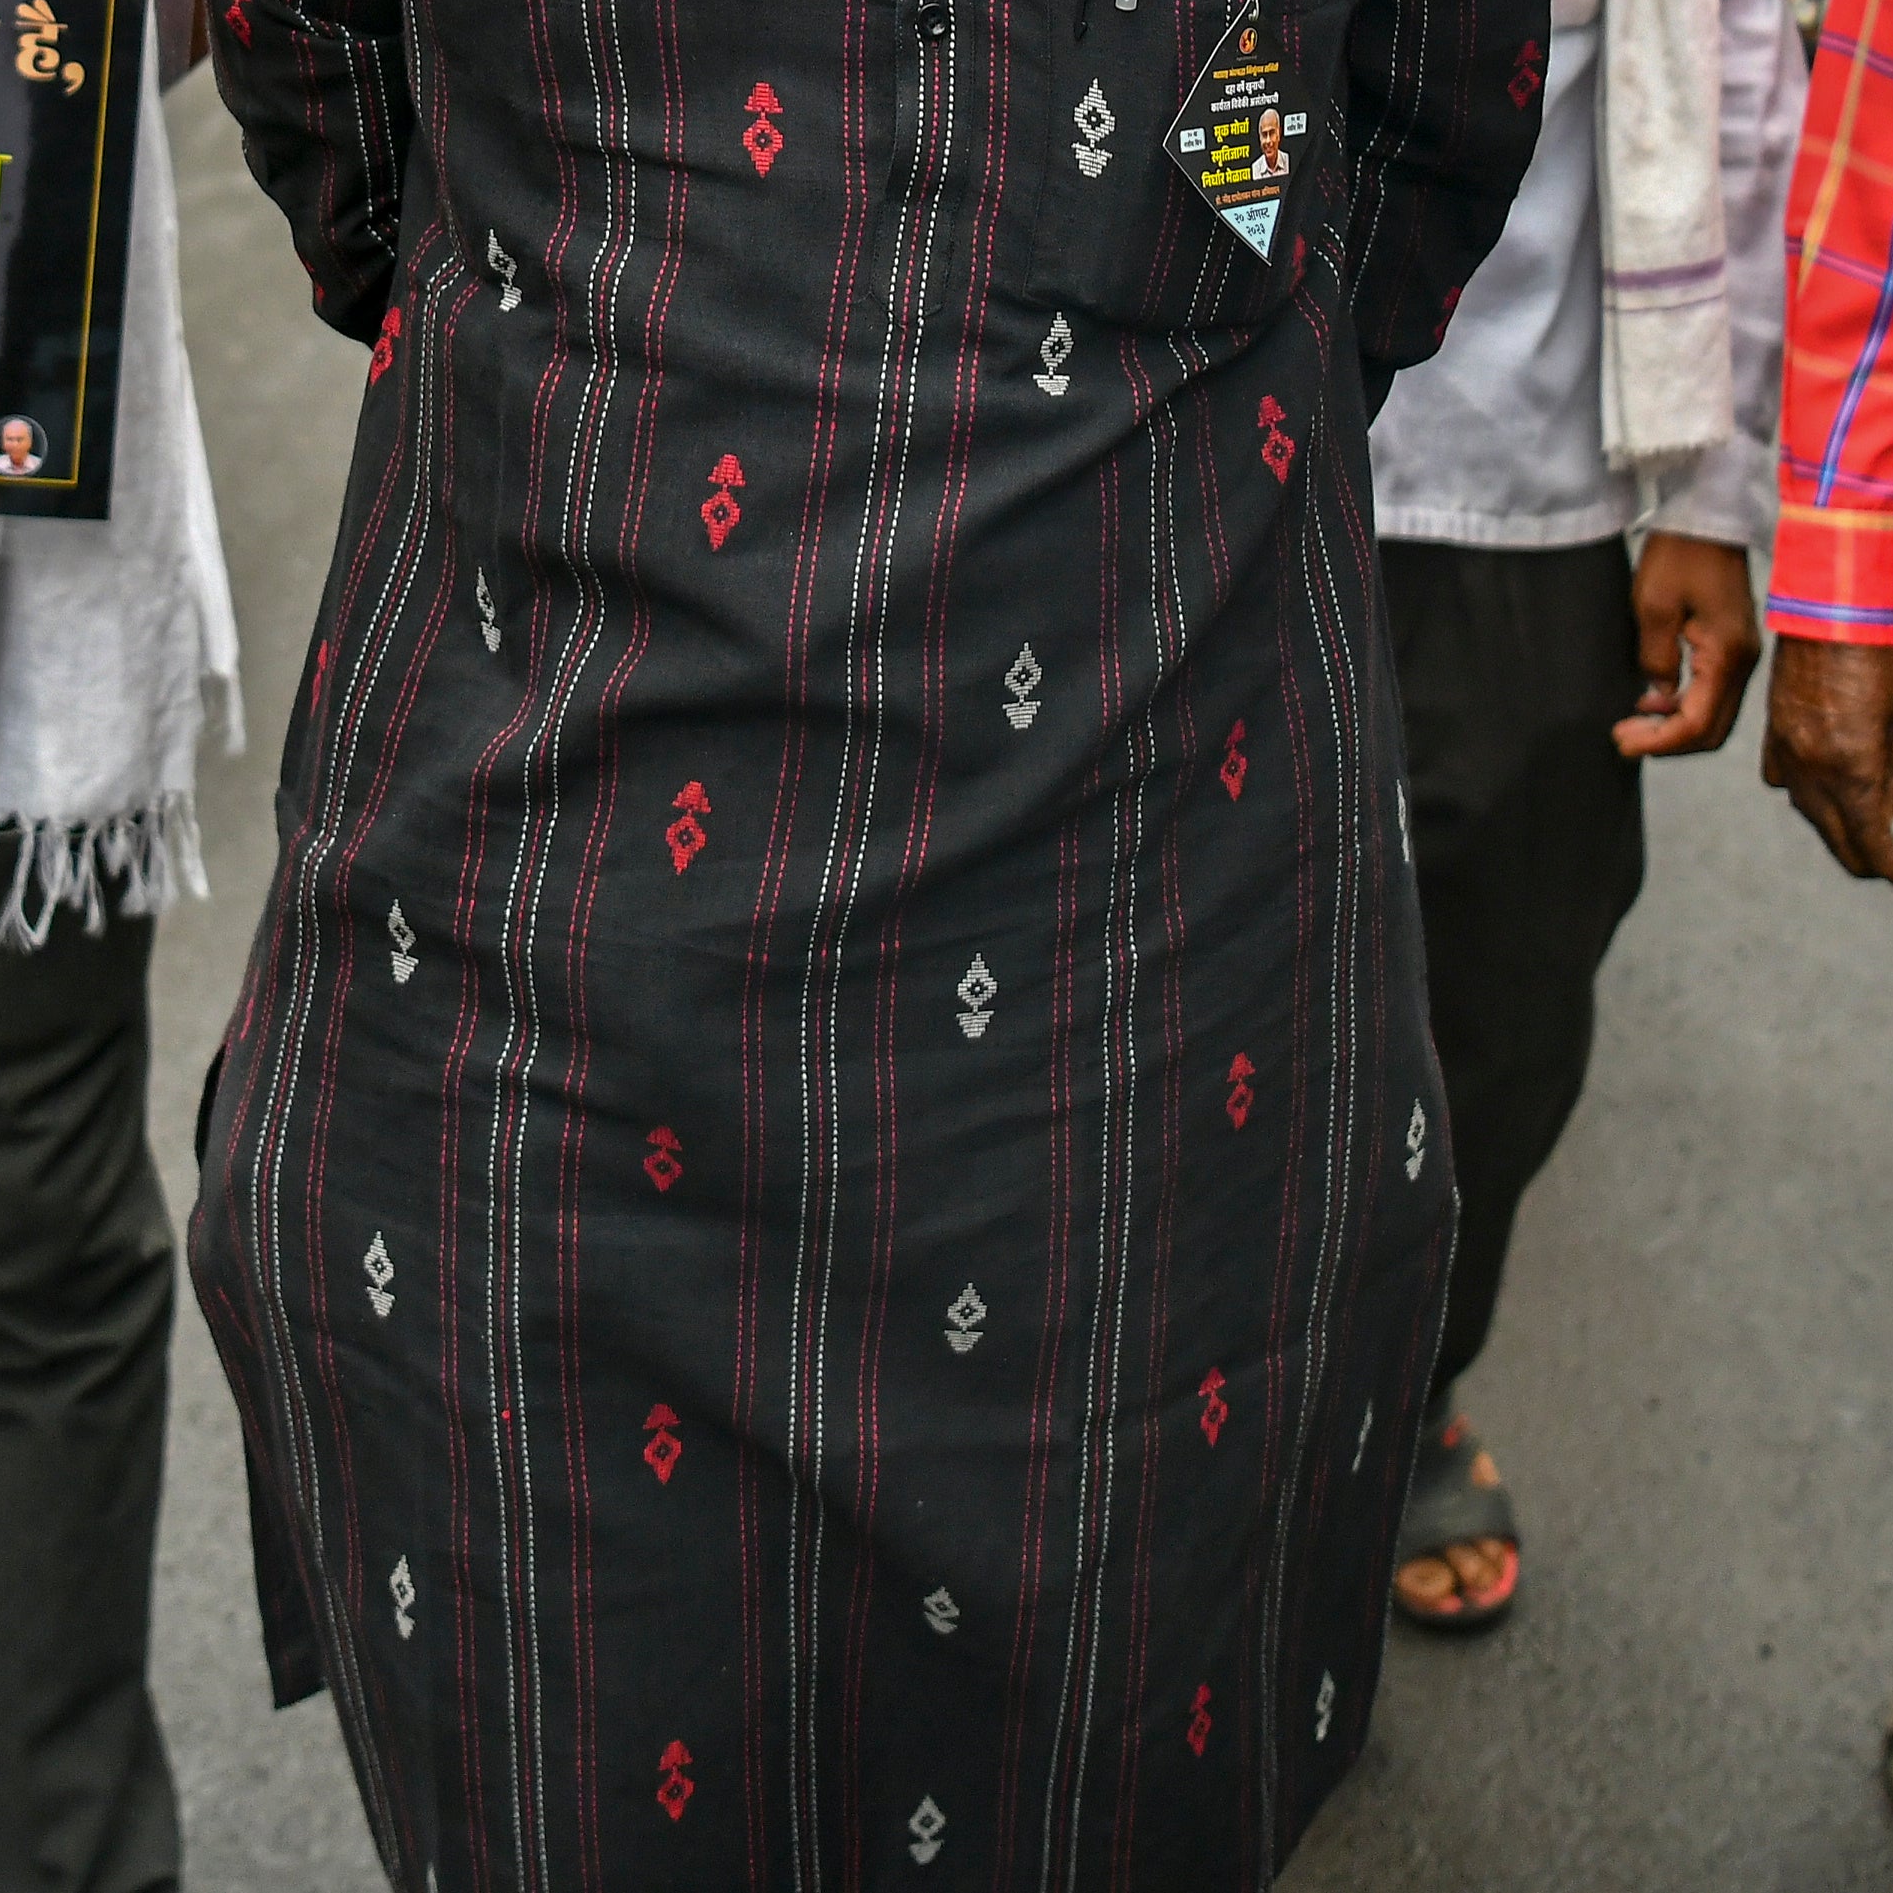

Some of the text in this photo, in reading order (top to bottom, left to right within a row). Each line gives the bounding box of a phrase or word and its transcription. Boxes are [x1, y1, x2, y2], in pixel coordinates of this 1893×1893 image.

[1213, 117, 1250, 143] मूक मोर्चा
[1201, 167, 1251, 188] निर्धार मेळावा
[1234, 207, 1270, 223] २० ऑगस्ट
[1245, 223, 1266, 237] २०२३
